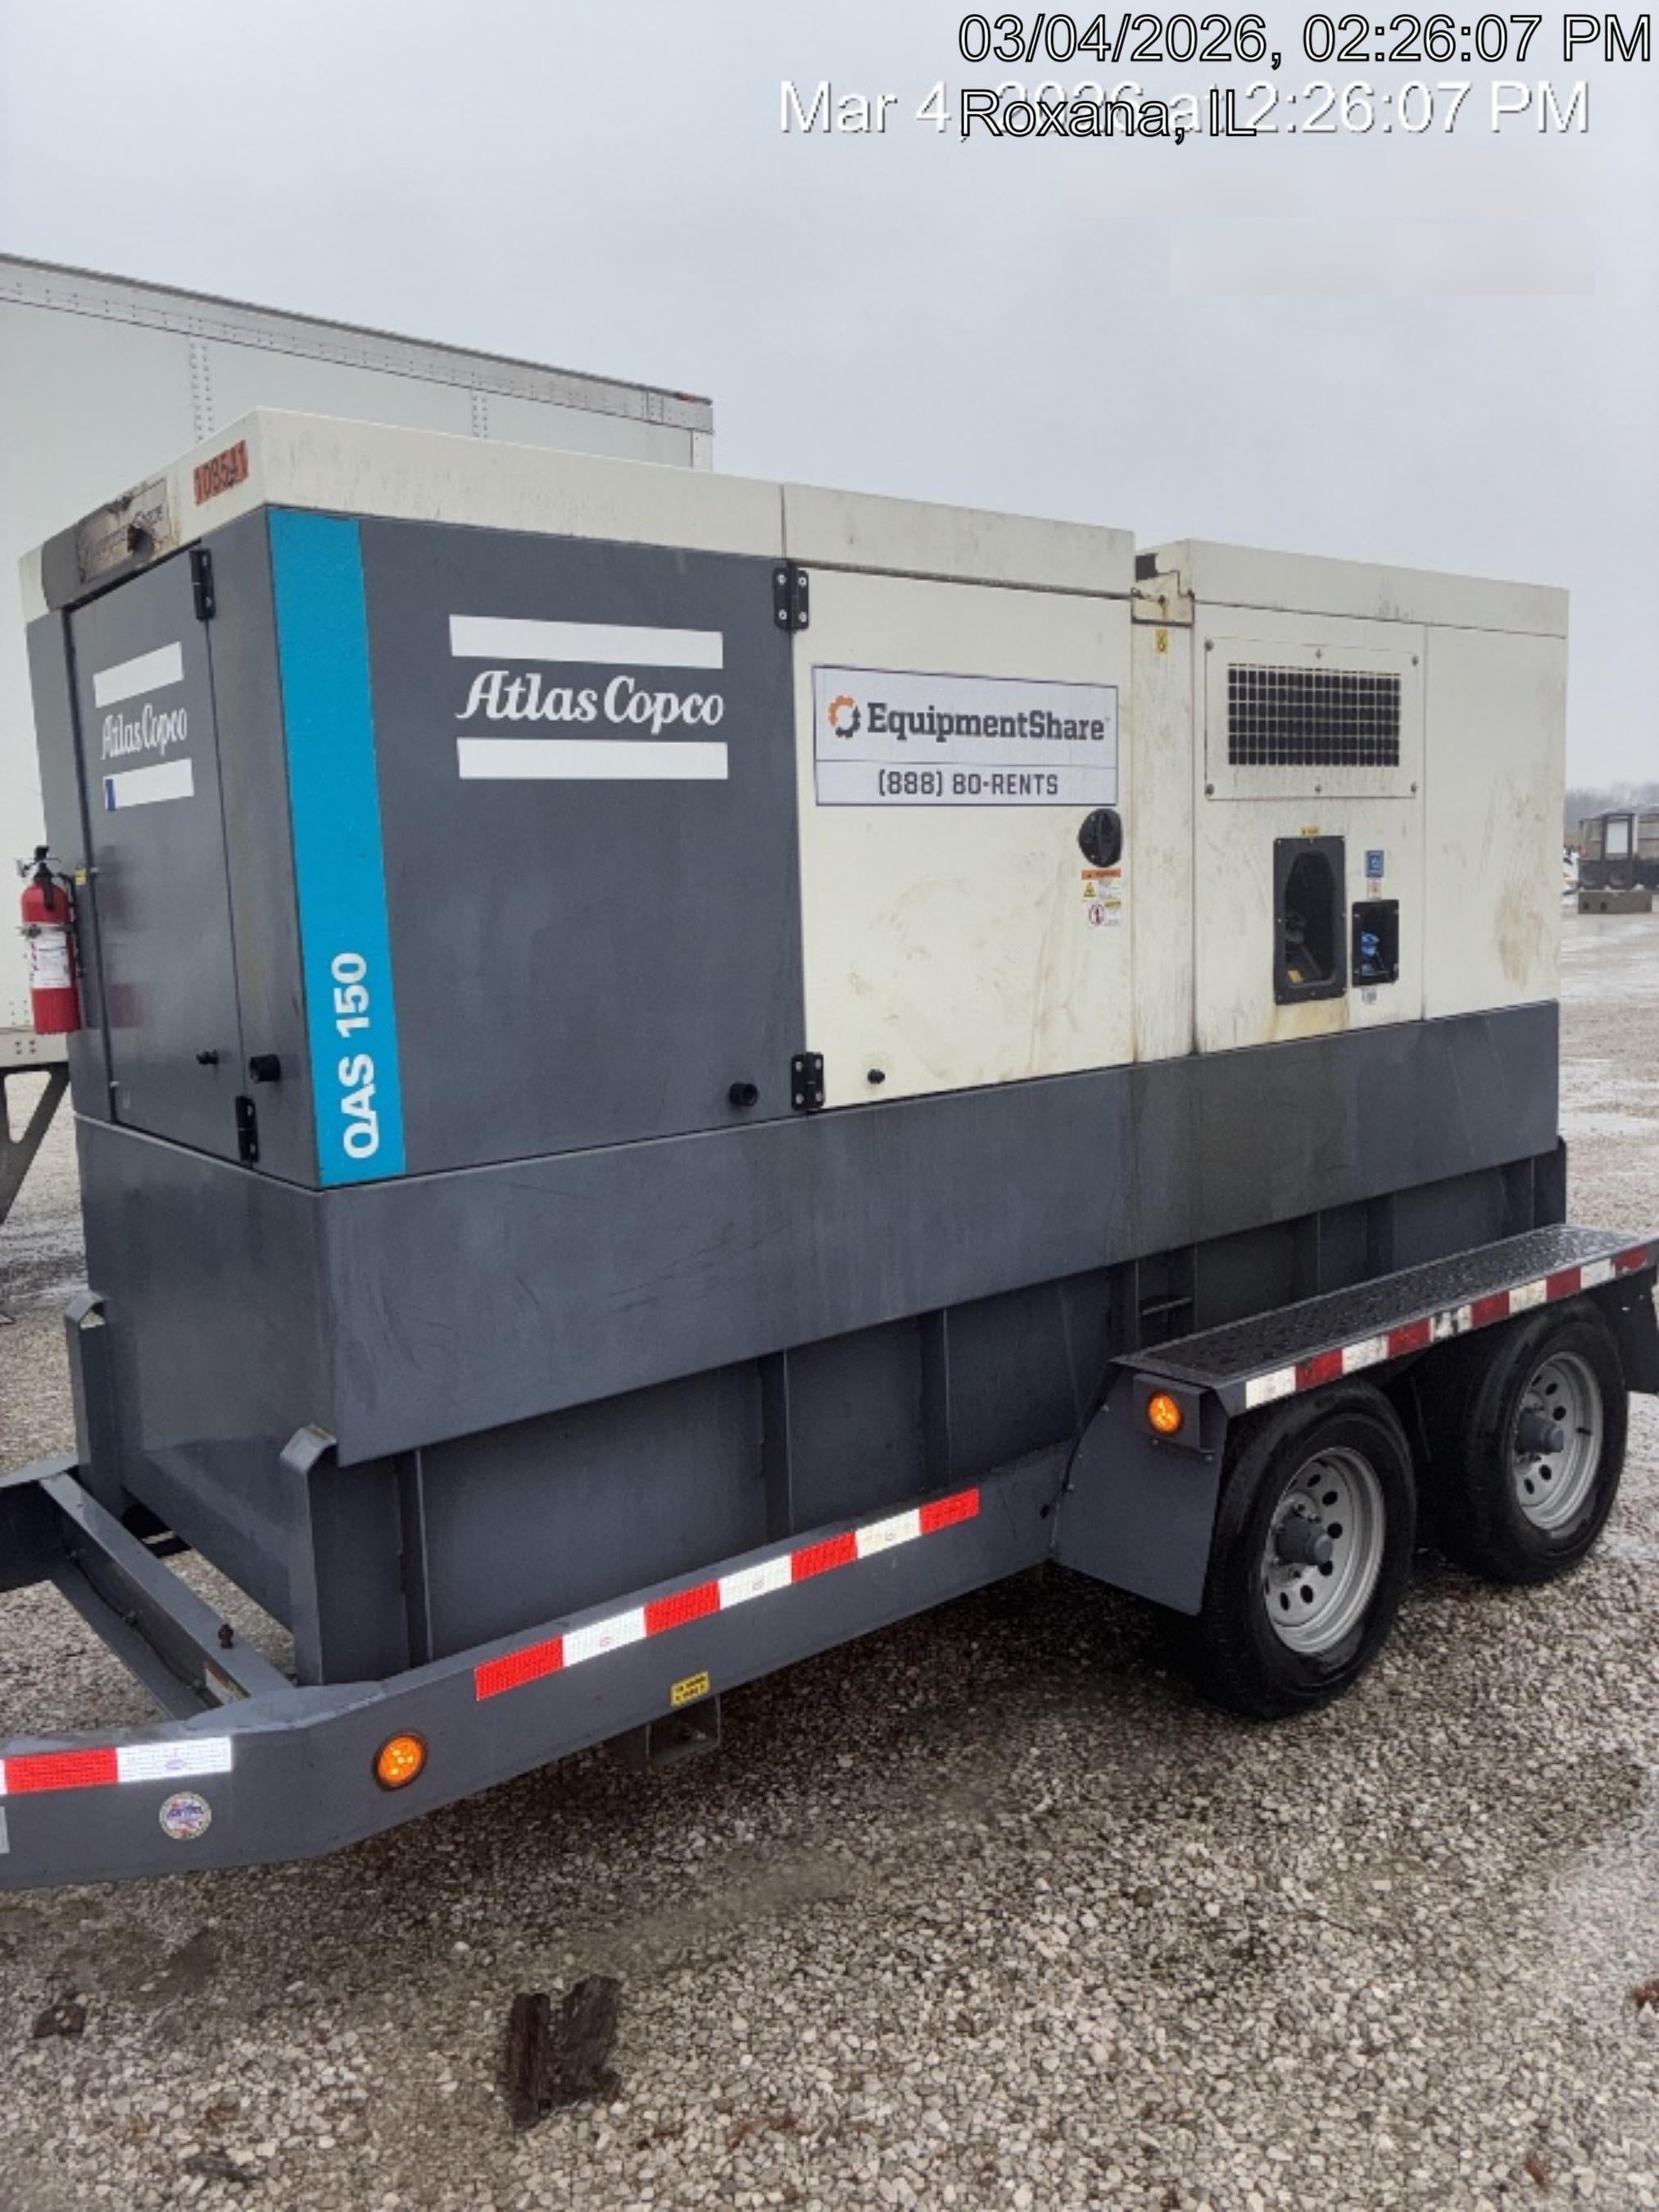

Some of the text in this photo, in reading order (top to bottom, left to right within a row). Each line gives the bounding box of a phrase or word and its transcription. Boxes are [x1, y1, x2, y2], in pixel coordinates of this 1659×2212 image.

[456, 669, 725, 736] Atlas Copco
[867, 701, 1105, 743] EquipmentShare
[879, 768, 1058, 797] (888) 80-RENTS
[331, 952, 379, 1159] QAS 150
